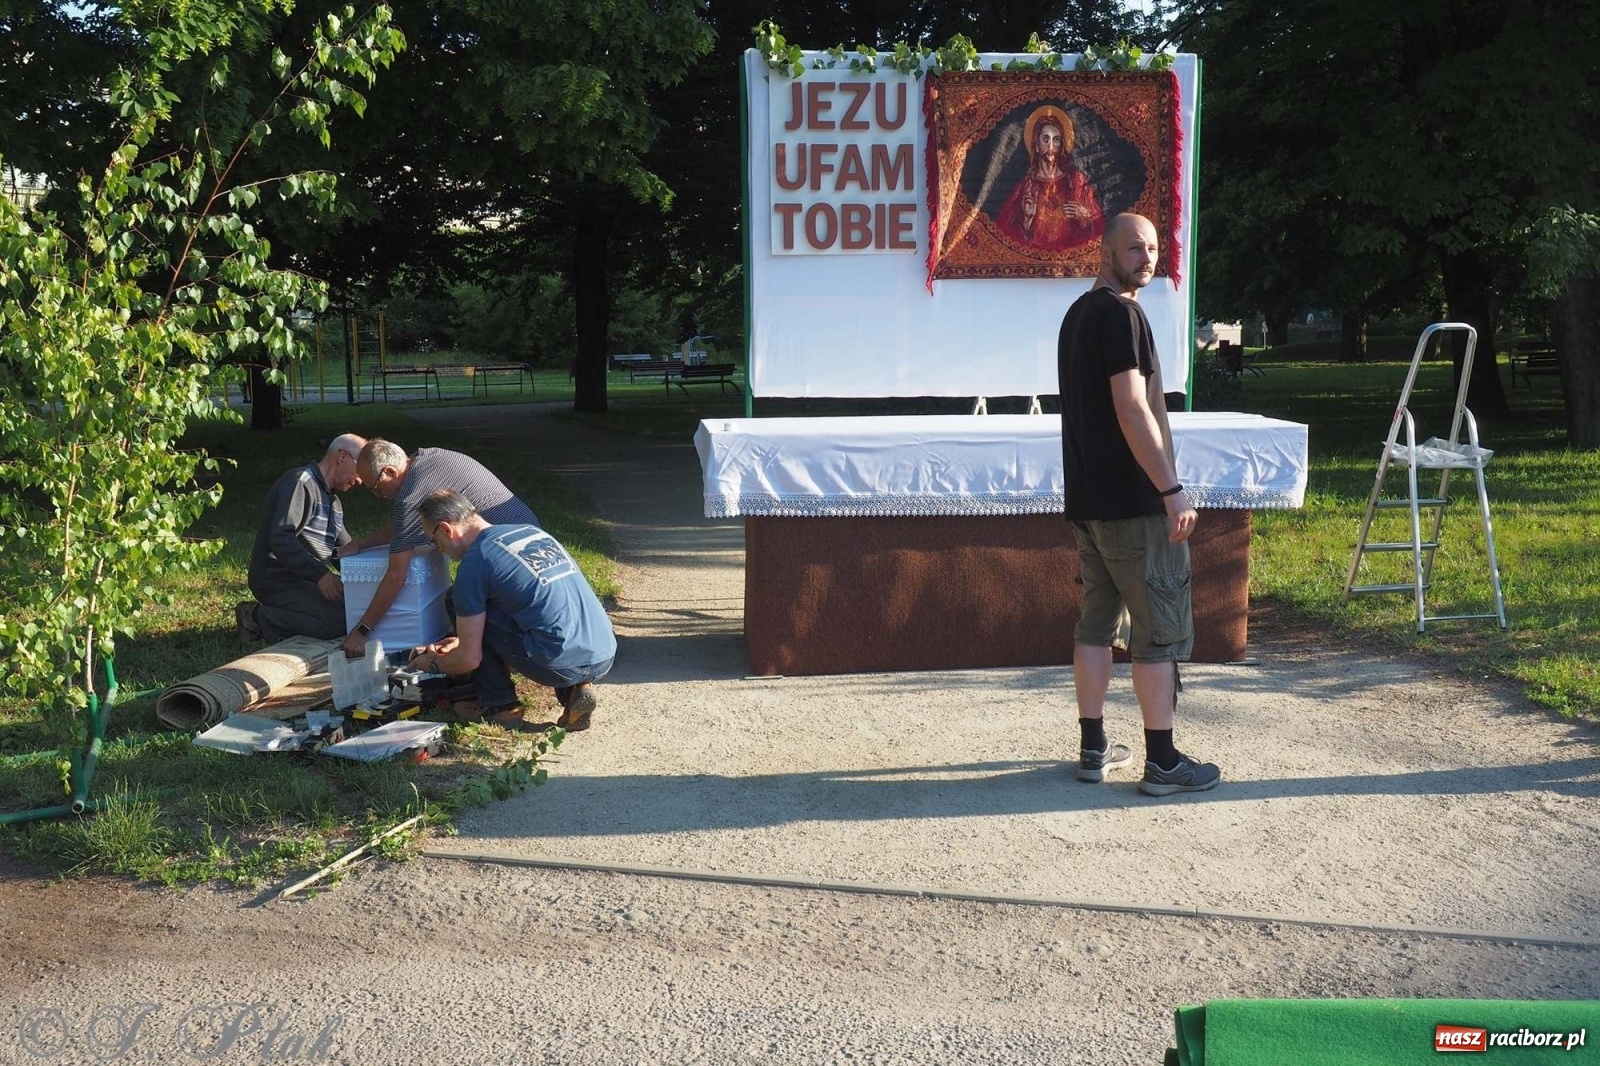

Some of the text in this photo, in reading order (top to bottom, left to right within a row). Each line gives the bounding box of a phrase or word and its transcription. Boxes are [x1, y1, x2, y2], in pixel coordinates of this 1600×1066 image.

[784, 81, 907, 131] JEZU
[775, 143, 914, 192] UFAM
[774, 203, 917, 250] TOBIE
